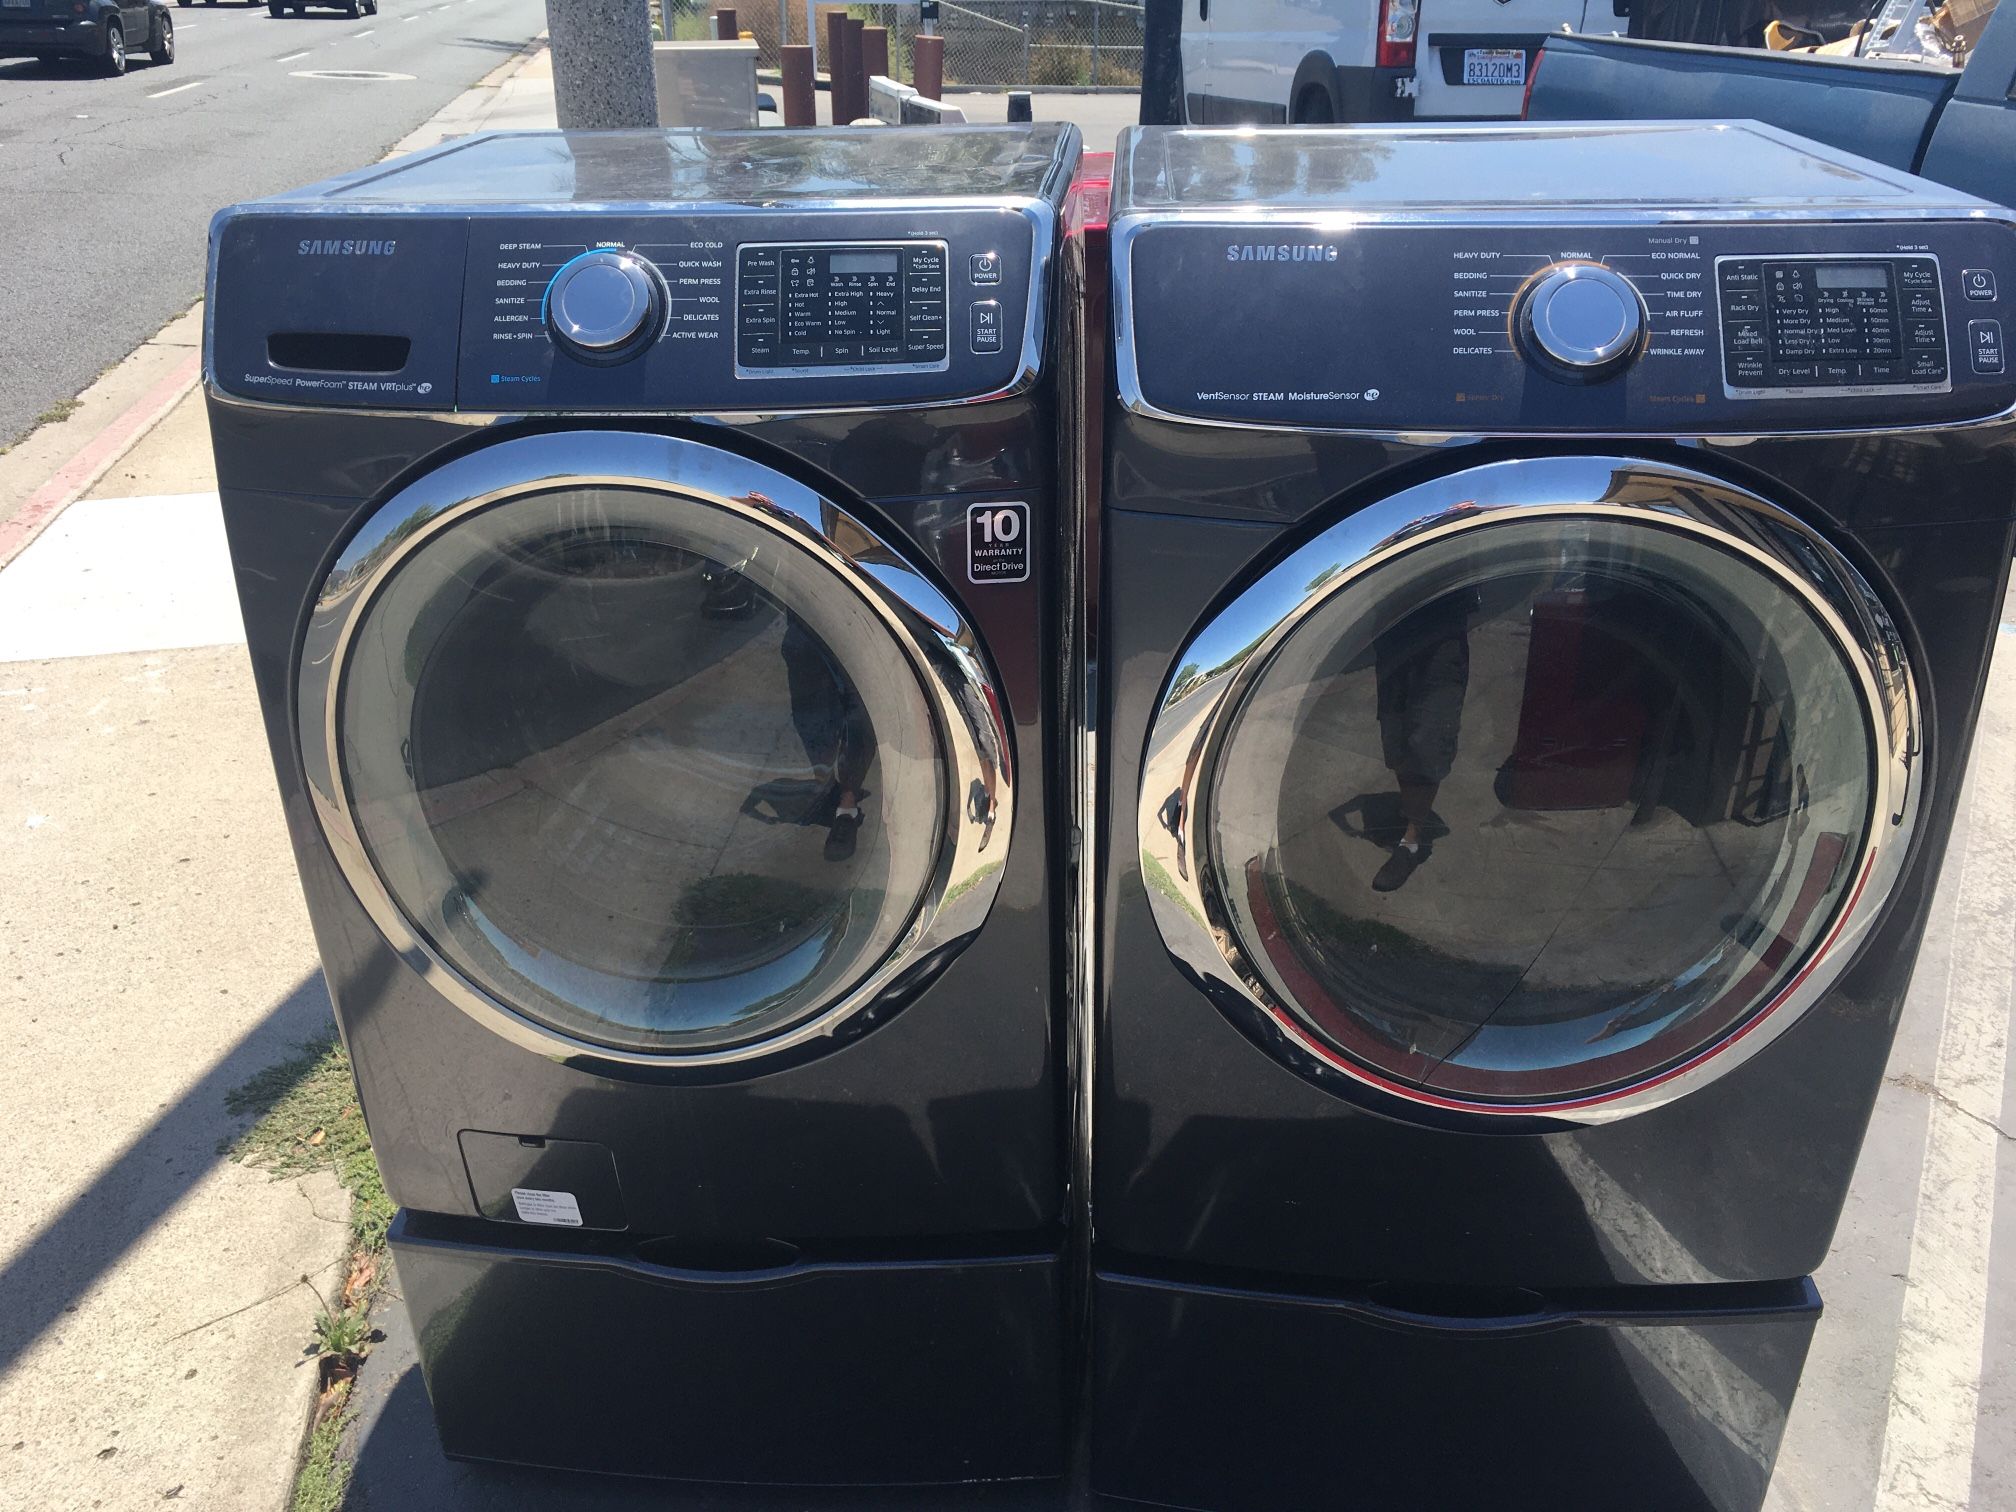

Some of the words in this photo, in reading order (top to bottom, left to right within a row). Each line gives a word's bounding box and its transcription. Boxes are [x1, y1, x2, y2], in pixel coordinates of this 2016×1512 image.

[298, 239, 396, 255] SAMSUNG
[1227, 245, 1338, 262] SAMSUNG
[1560, 251, 1593, 259] NORMAL
[678, 260, 700, 268] QUICK
[1660, 272, 1684, 280] QUICK
[672, 331, 697, 339] ACTIVE
[697, 331, 719, 339] WEAR
[1778, 368, 1790, 376] Dry
[244, 373, 293, 387] SuperSpeed
[347, 381, 378, 391] STEAM
[521, 375, 541, 383] Cycles
[1197, 391, 1250, 401] VentSensor
[1252, 392, 1284, 401] STEAM
[1288, 391, 1360, 401] MoistureSensor
[976, 509, 1020, 543] 10
[974, 548, 1023, 557] WARRANTY
[973, 562, 1000, 572] Direct
[1001, 562, 1024, 571] Drive
